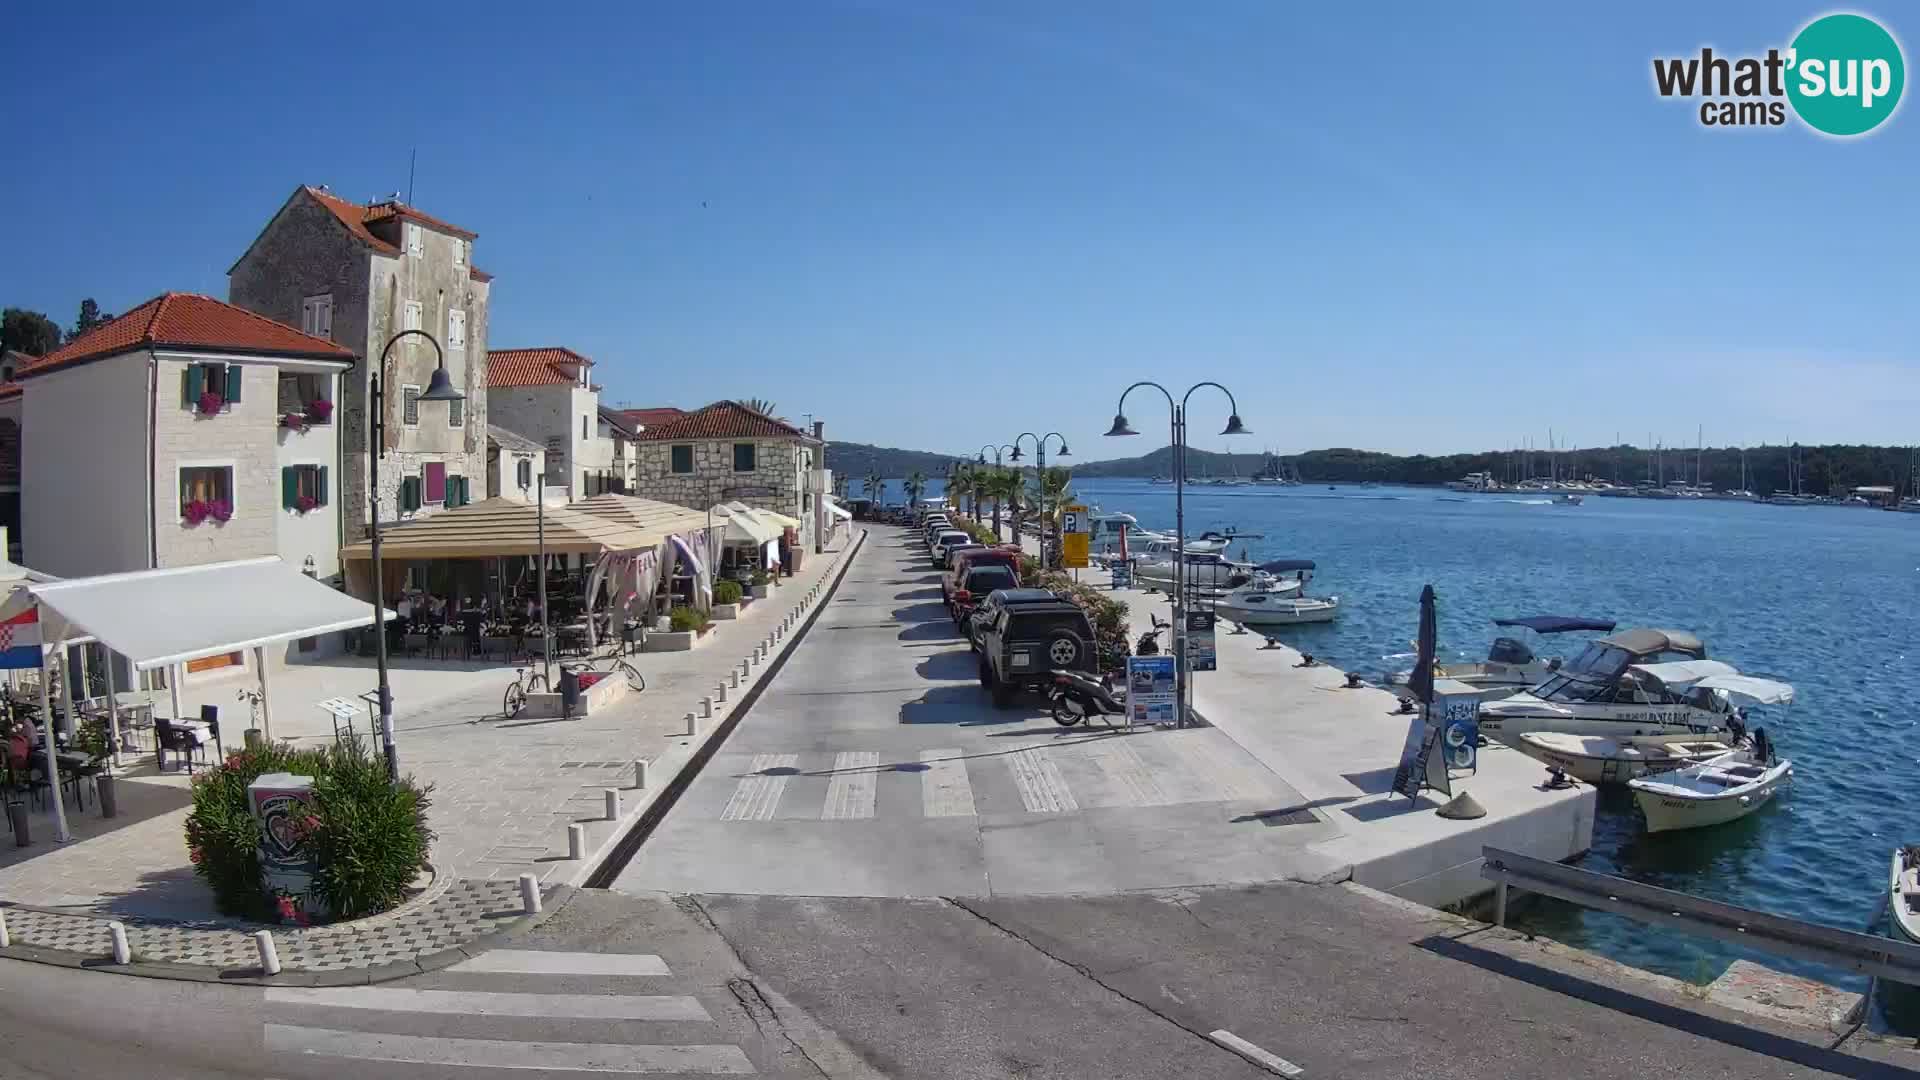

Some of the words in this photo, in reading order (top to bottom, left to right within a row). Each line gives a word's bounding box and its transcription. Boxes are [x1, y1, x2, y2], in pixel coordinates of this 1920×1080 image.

[1065, 514, 1075, 532] P
[1447, 702, 1477, 712] RENT
[1446, 712, 1453, 720] A
[1454, 712, 1478, 720] BOAT
